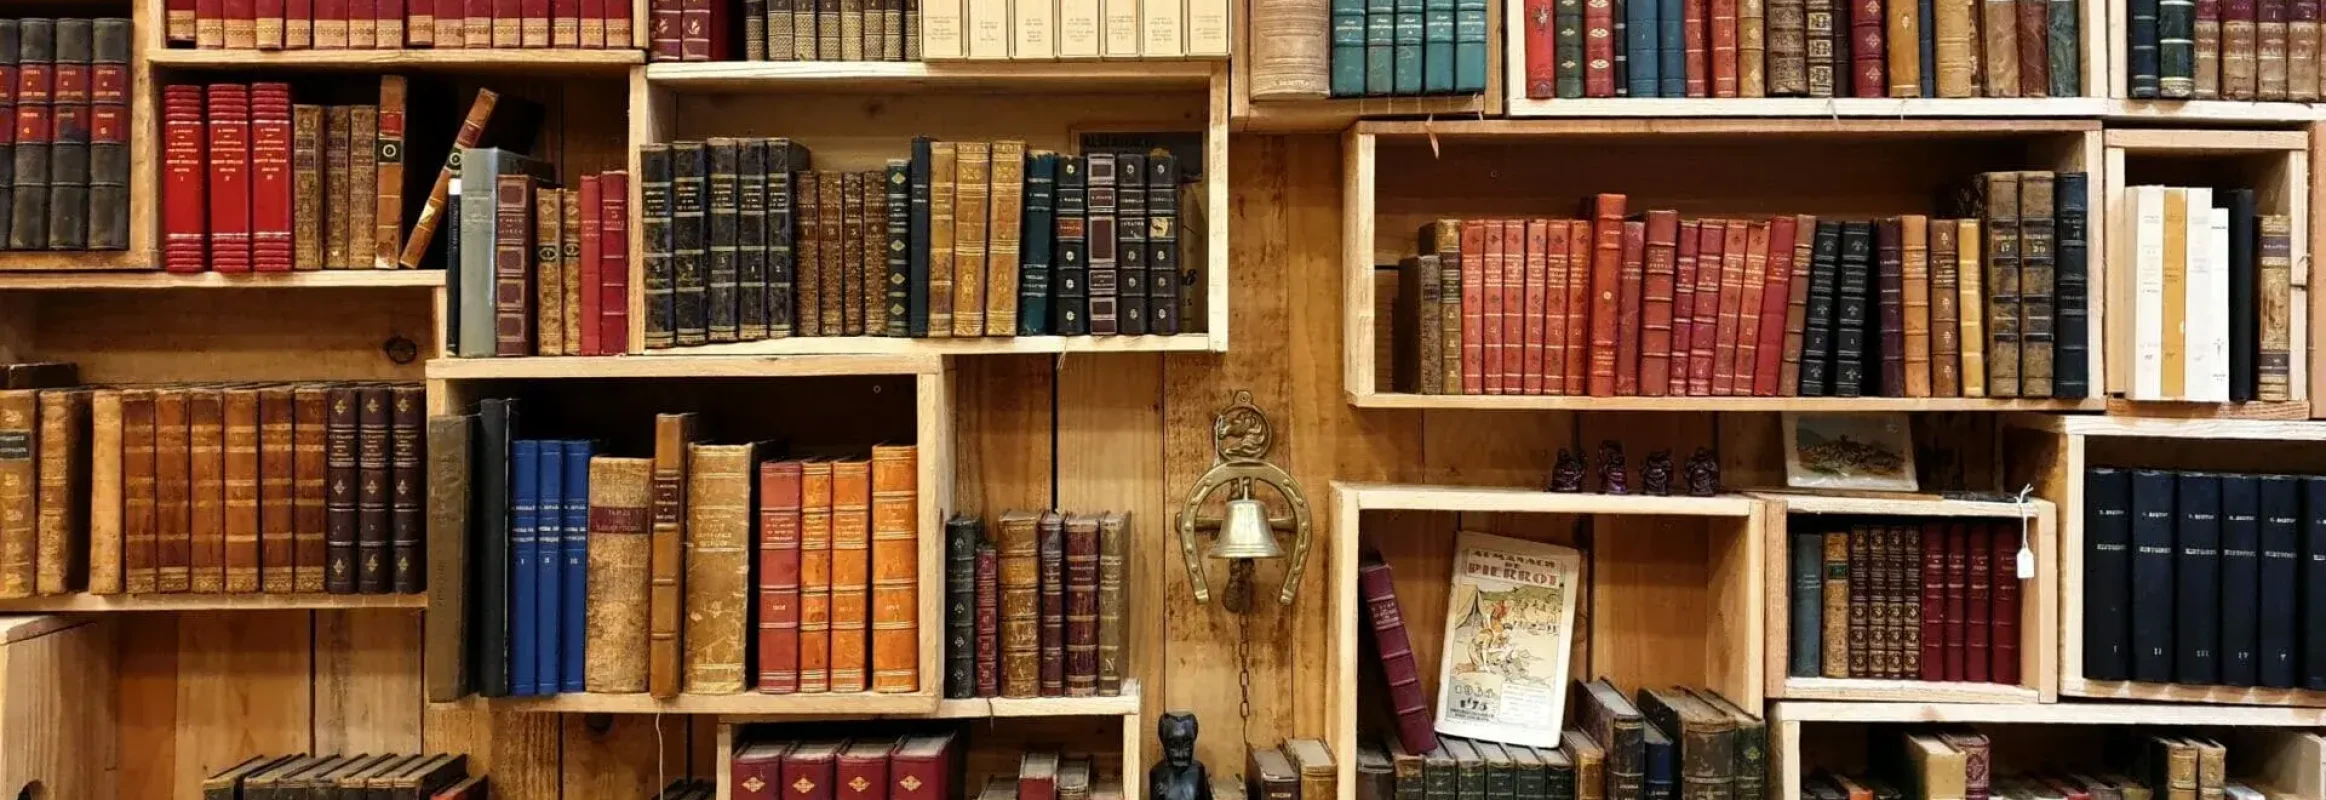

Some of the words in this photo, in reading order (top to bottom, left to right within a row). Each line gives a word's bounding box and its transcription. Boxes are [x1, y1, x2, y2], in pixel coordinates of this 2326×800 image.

[1473, 549, 1555, 568] ALMANACH
[1504, 561, 1521, 570] DE
[1468, 562, 1556, 586] PIERROT
